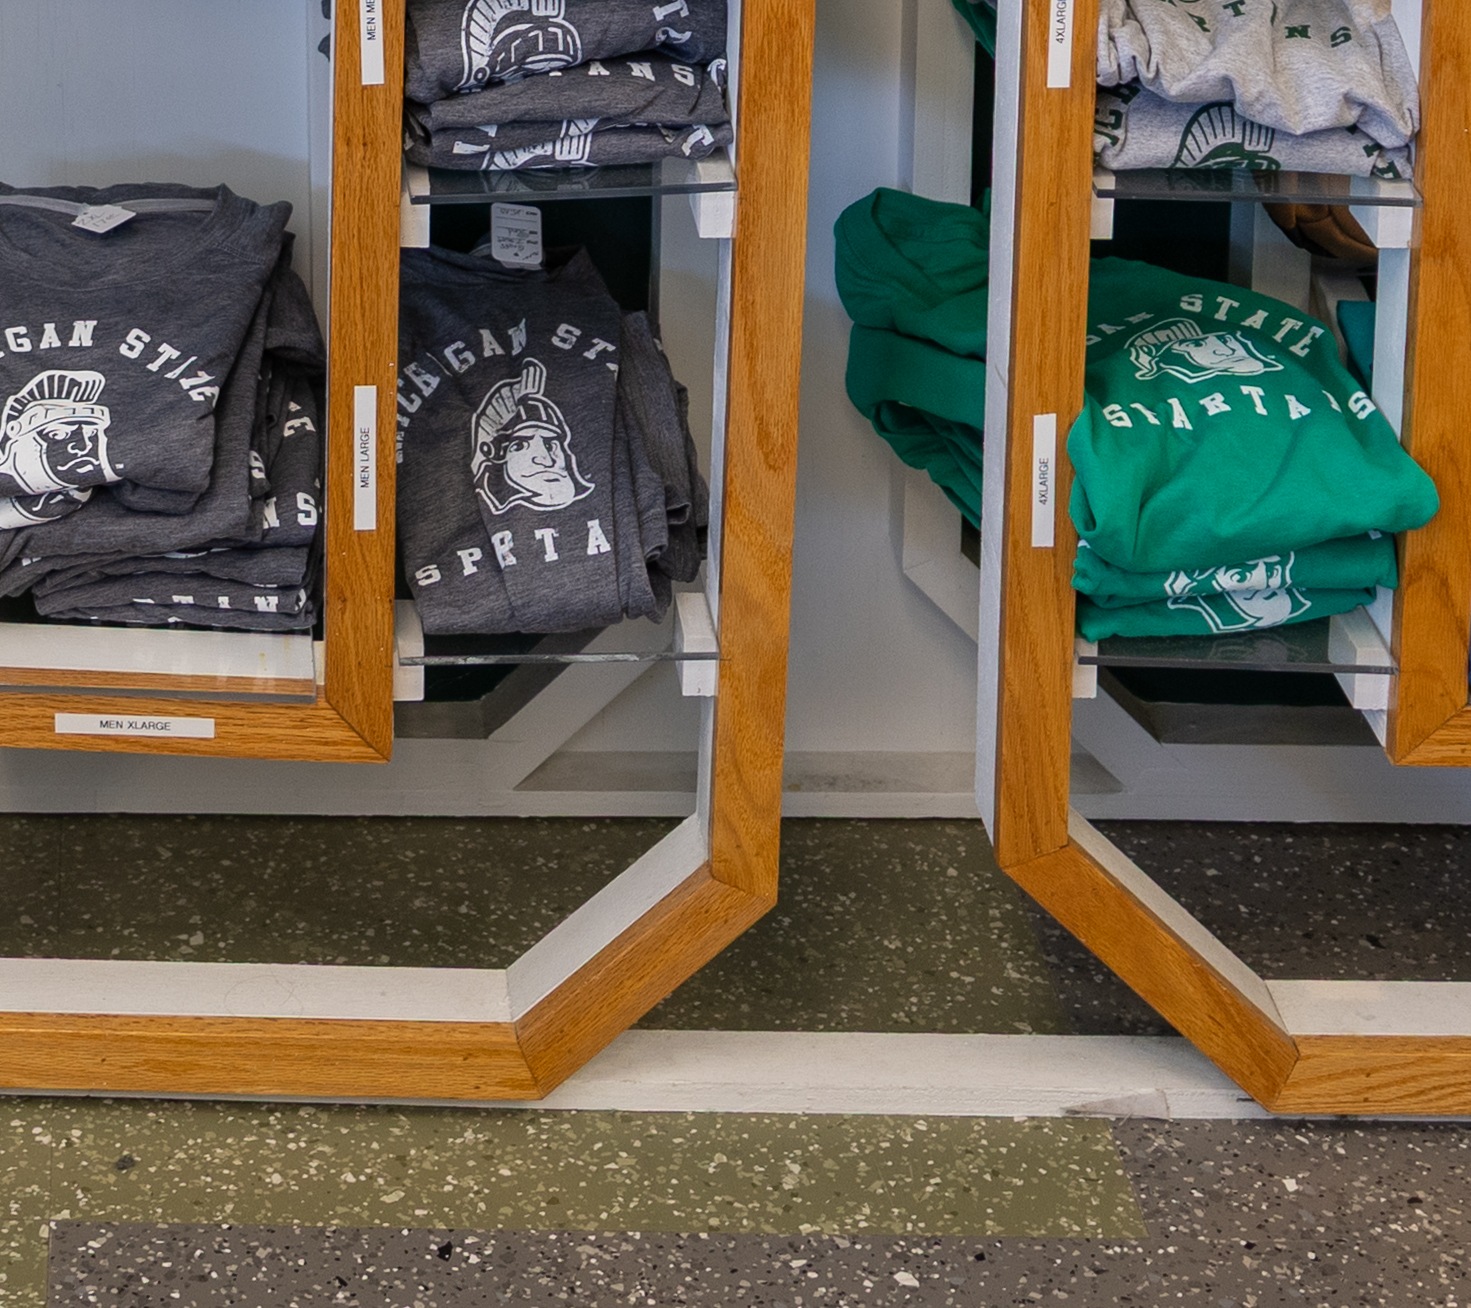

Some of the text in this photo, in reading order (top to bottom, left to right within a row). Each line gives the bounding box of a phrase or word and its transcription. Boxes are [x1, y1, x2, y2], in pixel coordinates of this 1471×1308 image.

[366, 17, 376, 41] MEN
[1180, 293, 1325, 358] STATE
[359, 427, 370, 488] MEN LARGE
[1038, 458, 1049, 506] 4XLARGE
[99, 720, 171, 731] MEN XLARGE
